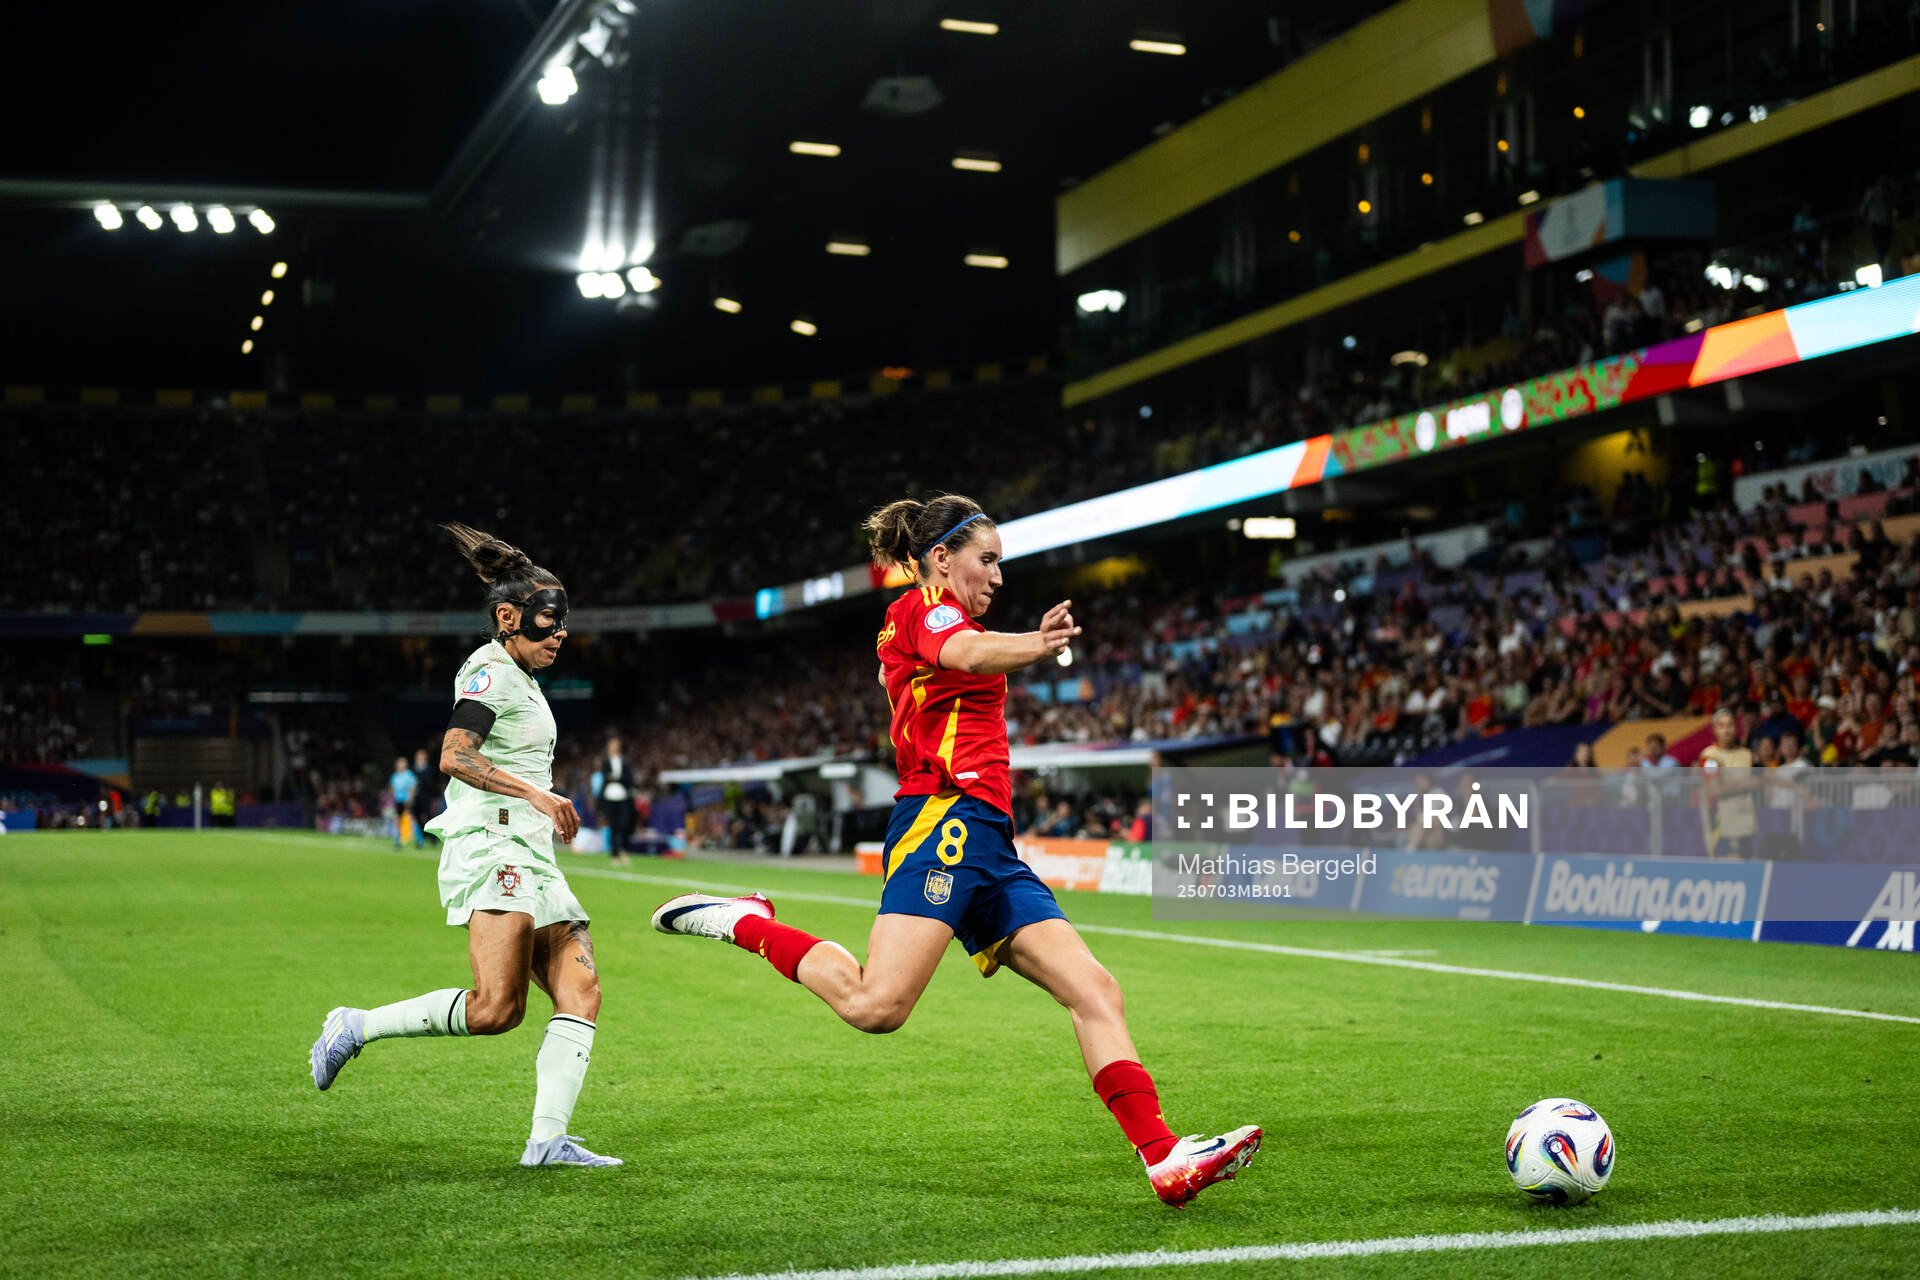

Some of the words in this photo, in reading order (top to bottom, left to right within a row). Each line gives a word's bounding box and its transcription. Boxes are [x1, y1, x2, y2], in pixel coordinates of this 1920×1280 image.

[935, 818, 968, 866] 8
[1402, 855, 1500, 903] euronics
[1544, 859, 1747, 933] Booking.com
